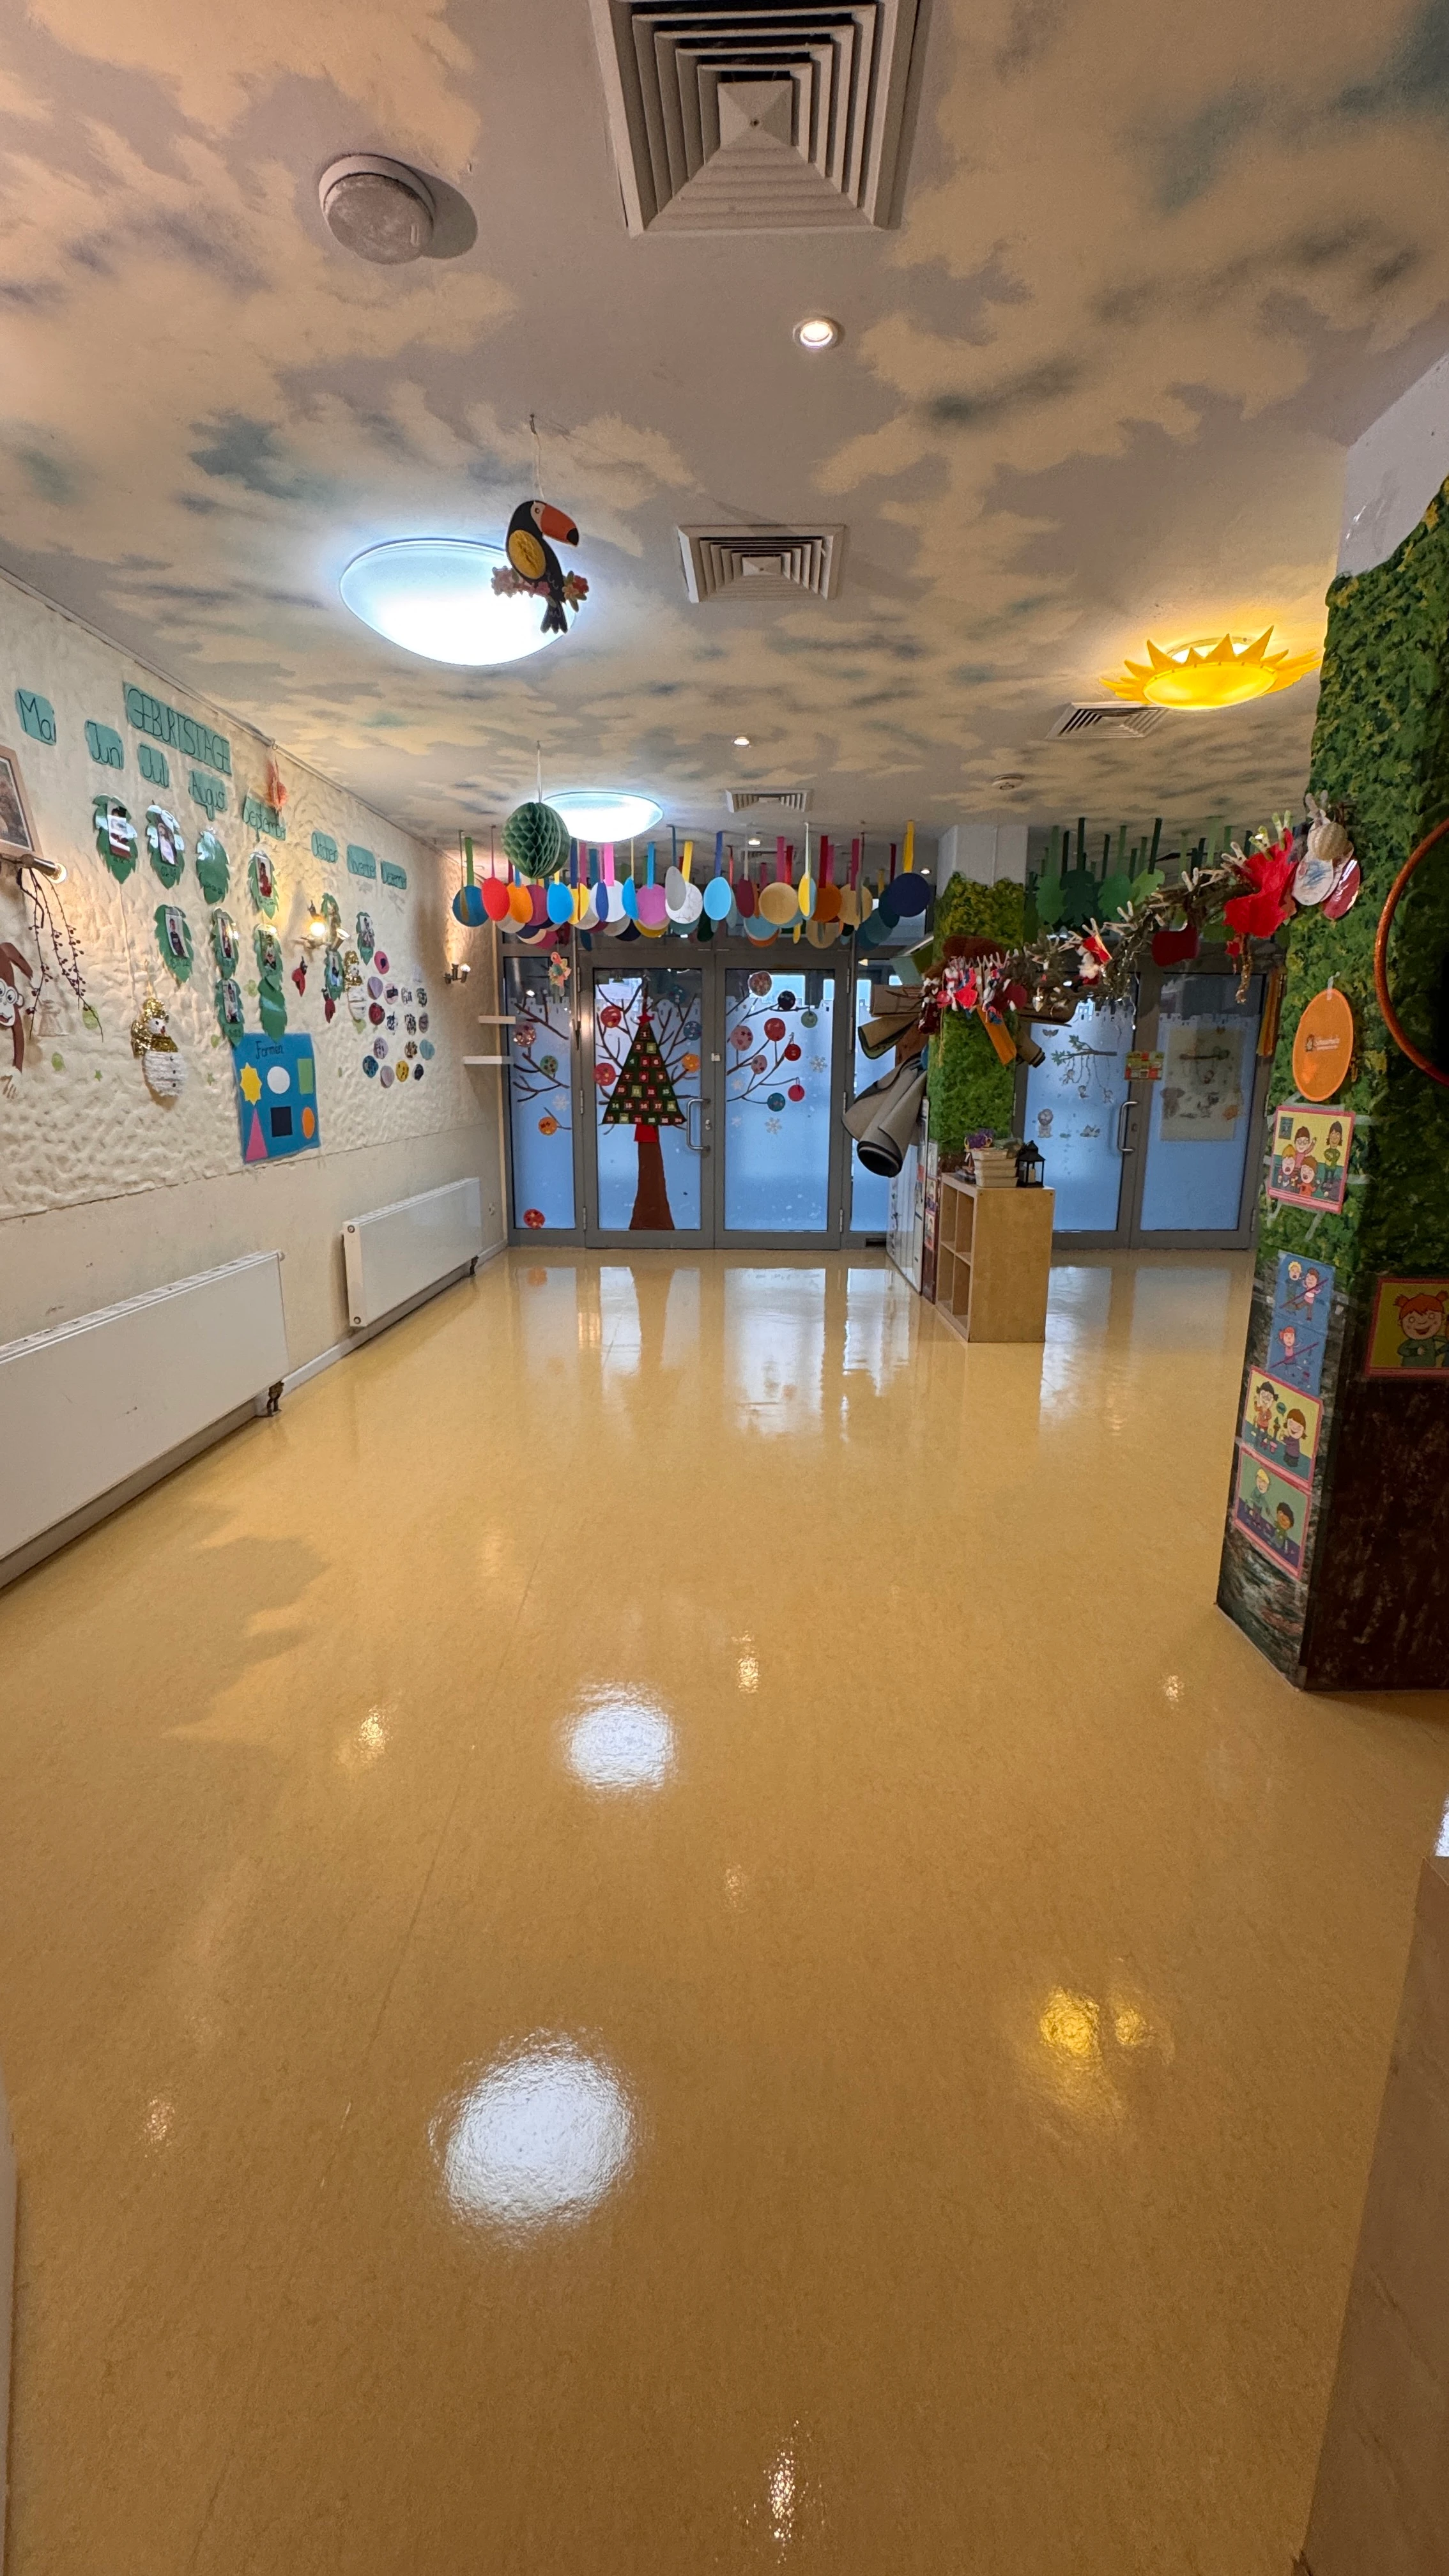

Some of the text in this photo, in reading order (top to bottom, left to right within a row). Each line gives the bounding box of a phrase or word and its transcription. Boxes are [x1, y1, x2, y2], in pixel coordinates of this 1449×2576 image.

[18, 691, 56, 744] Mai
[128, 688, 231, 776] GEBURTSTAGE
[87, 721, 123, 770] Juni
